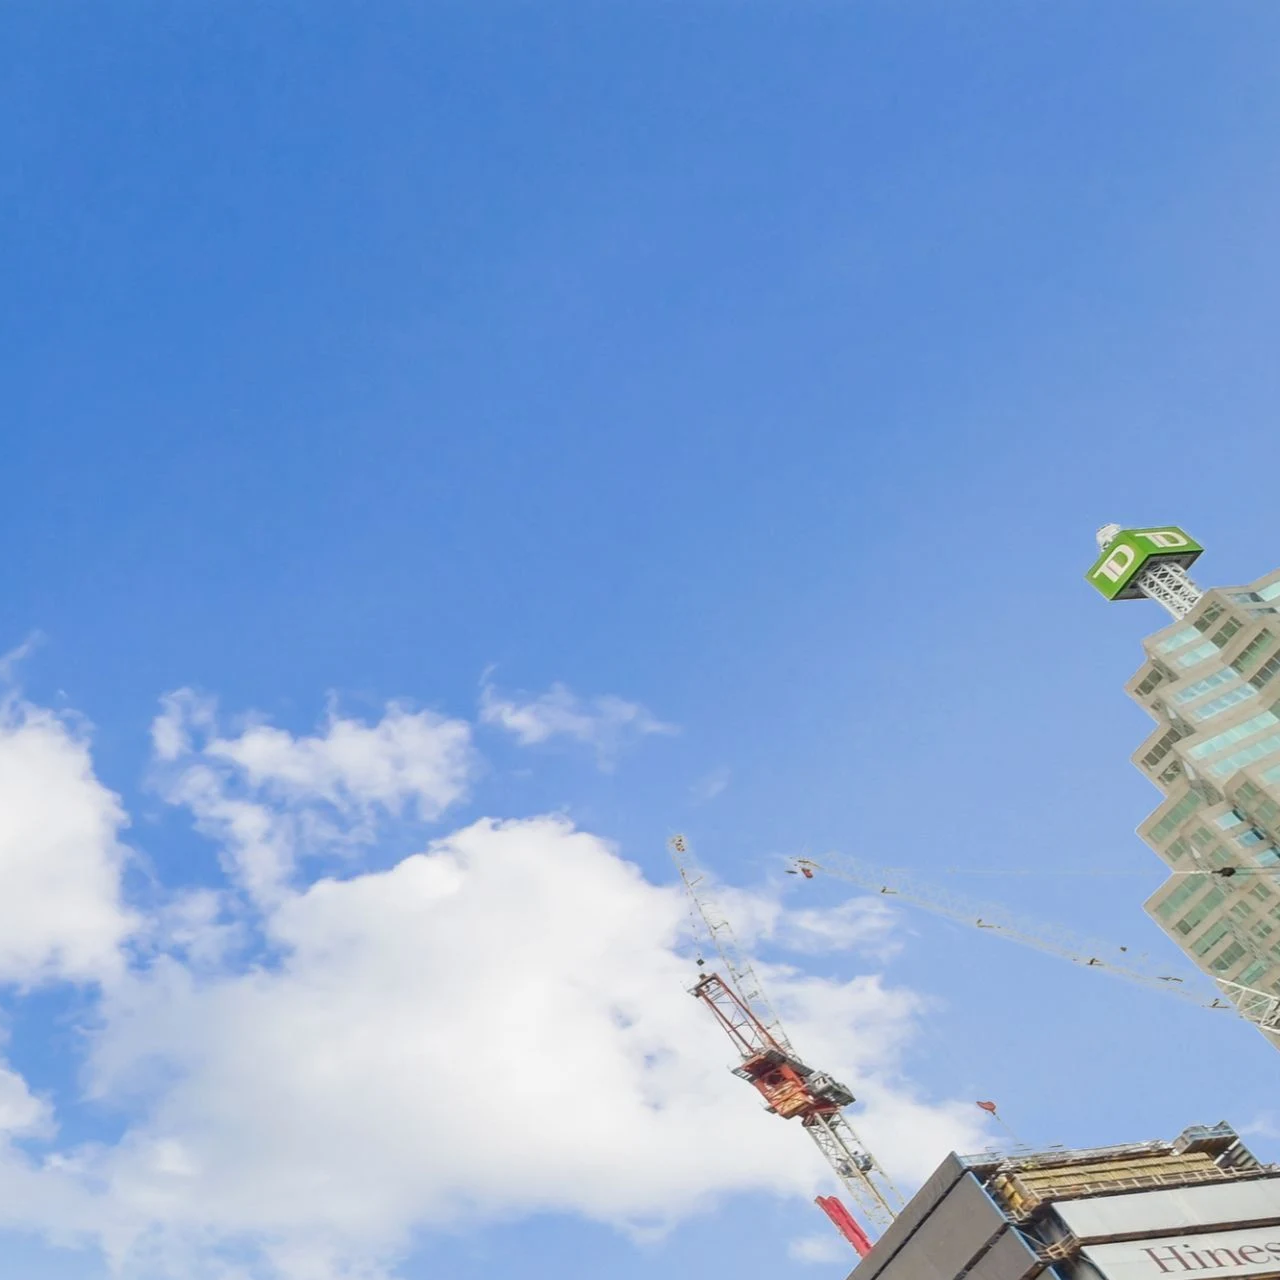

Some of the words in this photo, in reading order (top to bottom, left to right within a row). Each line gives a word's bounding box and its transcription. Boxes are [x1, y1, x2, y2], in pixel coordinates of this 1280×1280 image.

[1135, 531, 1189, 548] TD
[1092, 543, 1135, 583] TD
[1140, 1242, 1280, 1274] Hines
